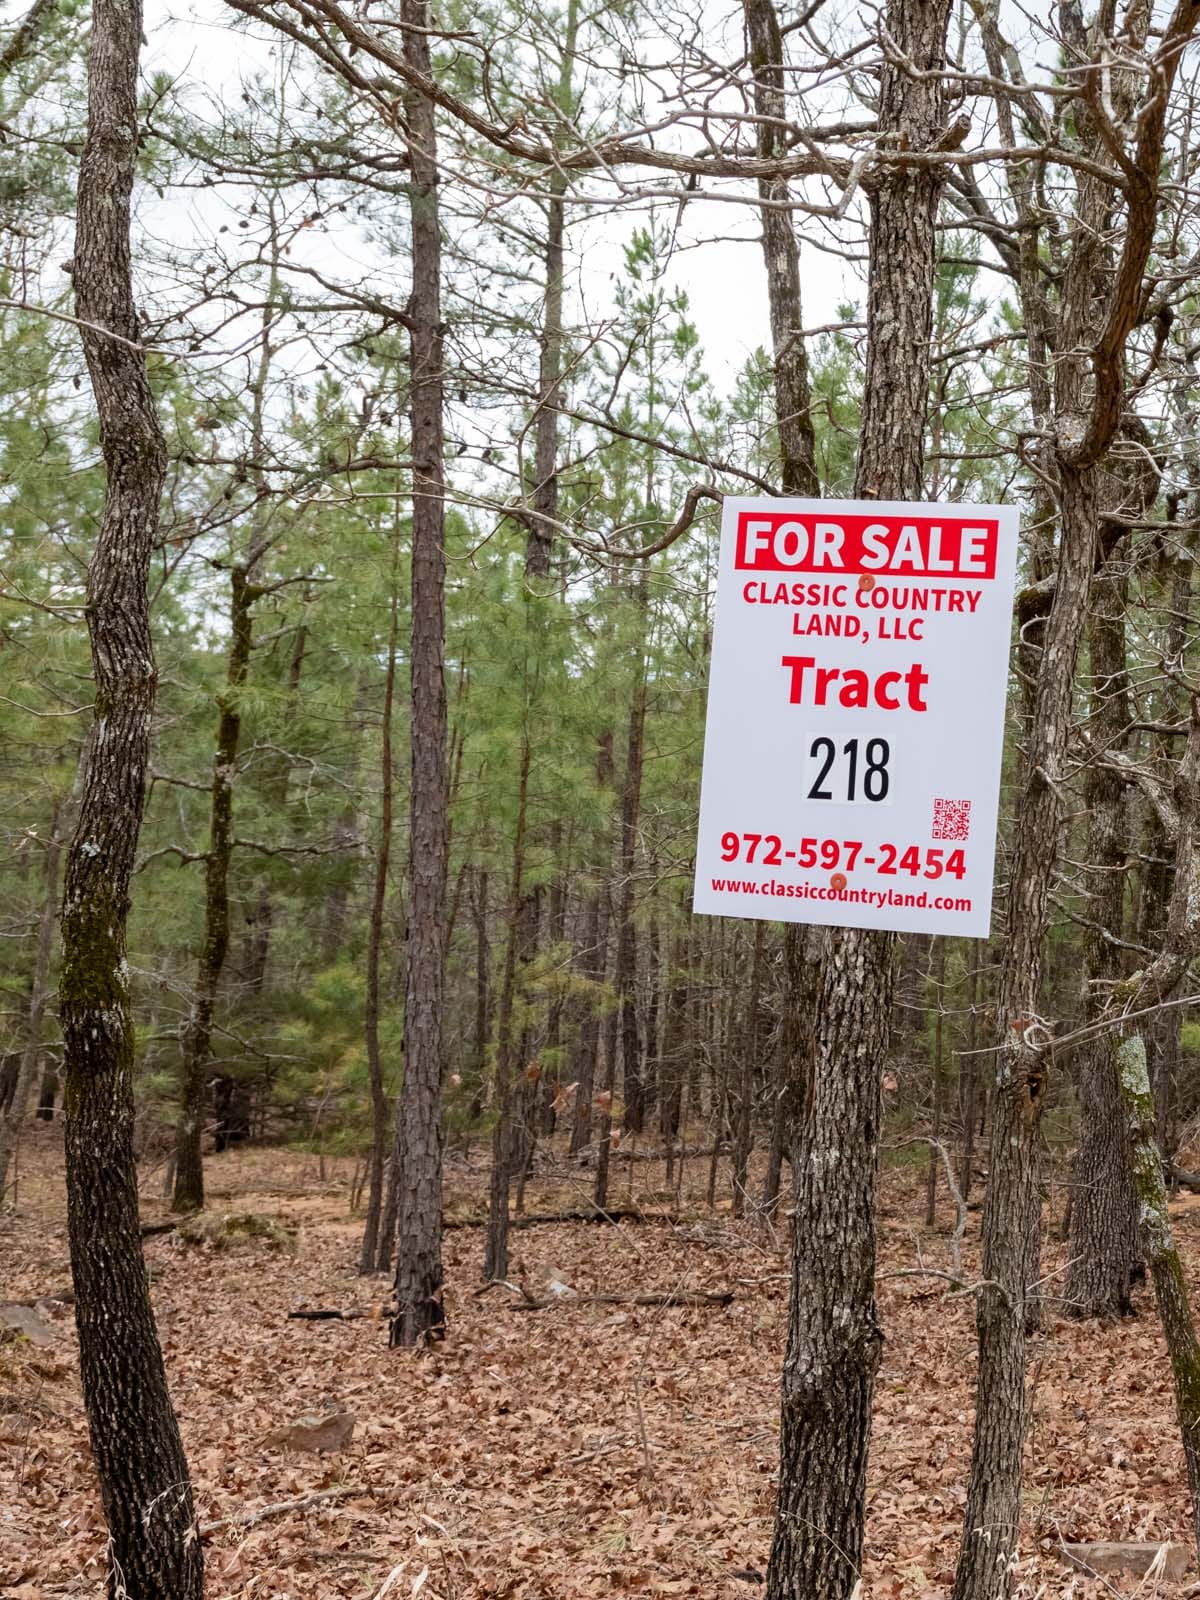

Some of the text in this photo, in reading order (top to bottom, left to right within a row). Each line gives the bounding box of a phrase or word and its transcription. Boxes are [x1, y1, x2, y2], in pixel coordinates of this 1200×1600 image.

[743, 520, 989, 573] FOR SALE
[743, 581, 983, 613] CLASSIC COUNTRY
[792, 613, 925, 644] LAND, LLC
[781, 656, 929, 712] Tract
[807, 737, 891, 802] 218
[720, 831, 967, 881] 972-597-2454
[711, 878, 972, 912] www.classiccountryland.com
